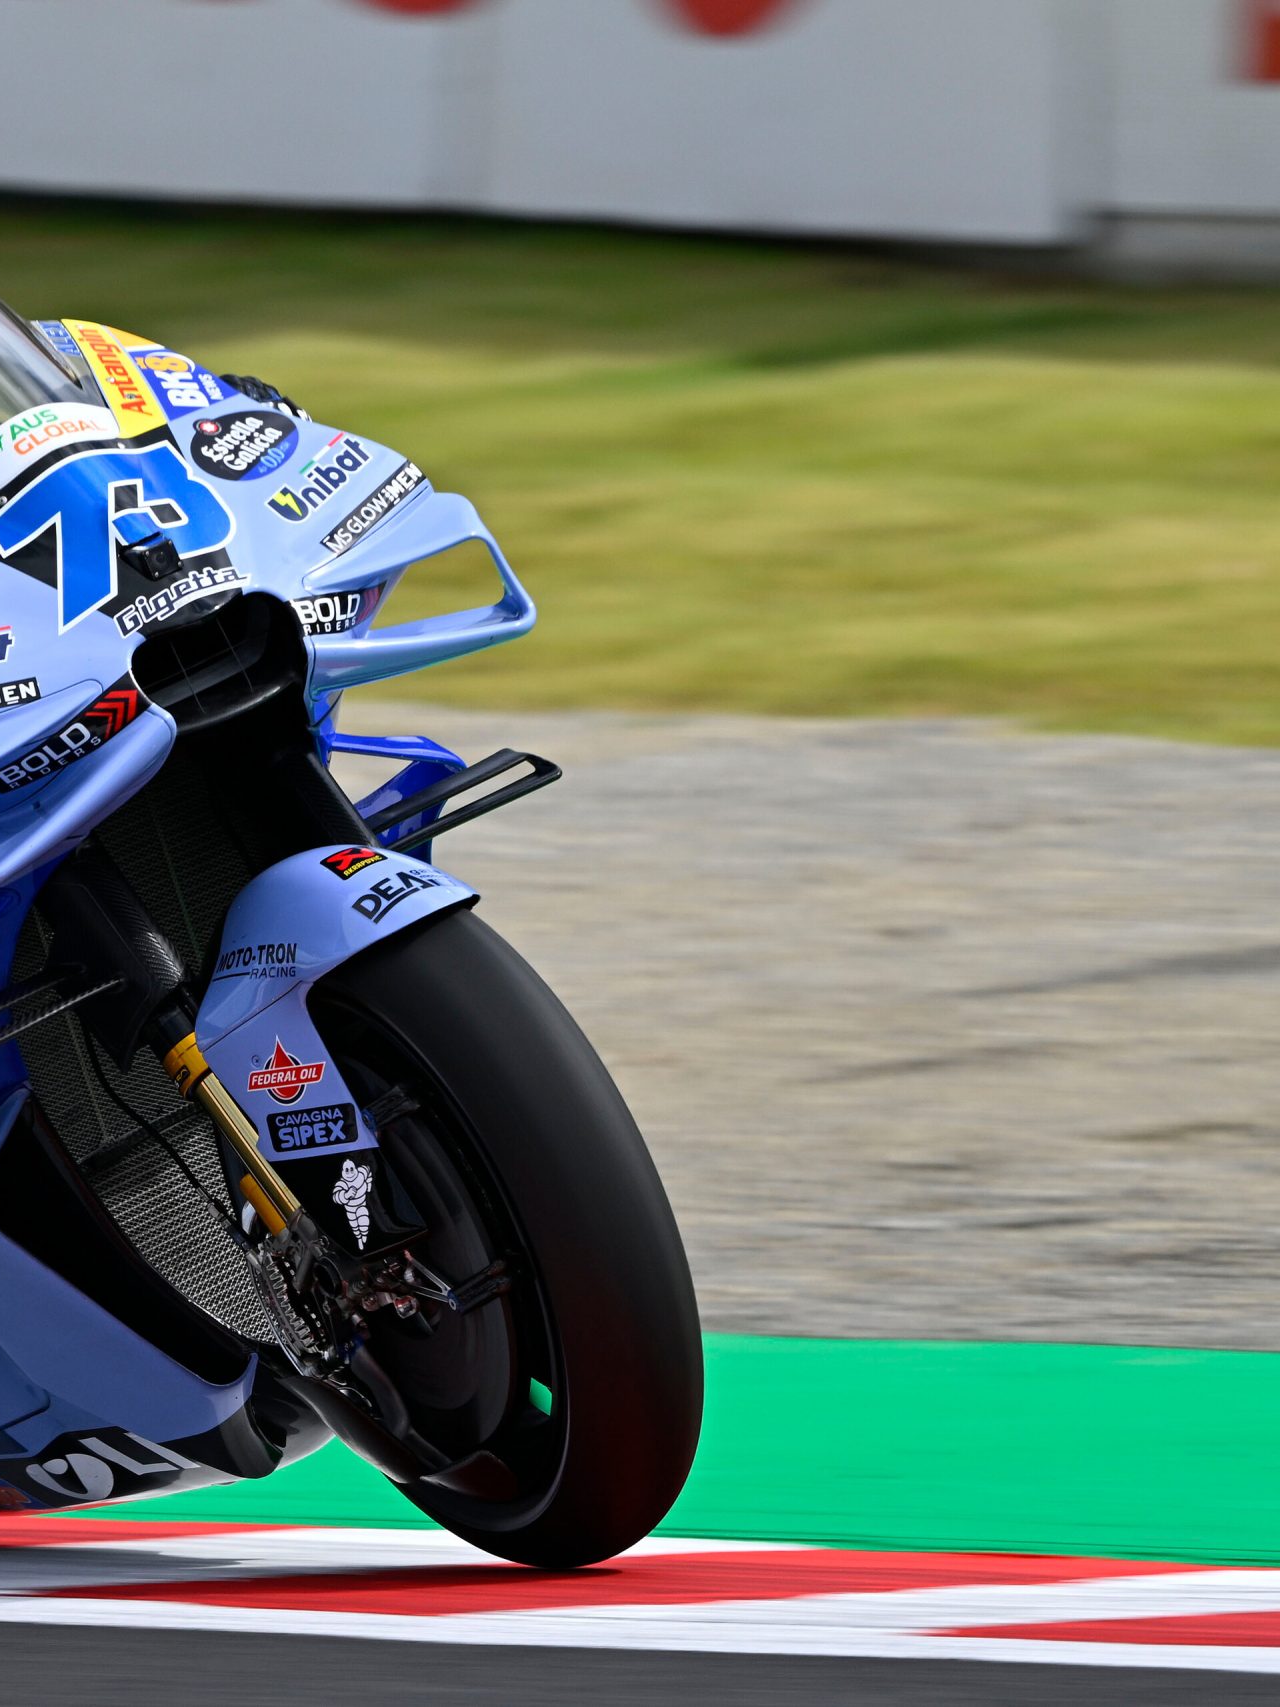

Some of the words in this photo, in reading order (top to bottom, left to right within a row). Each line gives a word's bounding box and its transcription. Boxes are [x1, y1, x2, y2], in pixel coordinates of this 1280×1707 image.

[79, 326, 153, 417] Antangin
[144, 353, 210, 408] BK8
[10, 409, 59, 441] AUS
[13, 418, 109, 456] GLOBAL
[201, 416, 264, 462] Estrella
[222, 427, 283, 471] Galicia
[267, 437, 370, 522] Unibat
[323, 527, 352, 556] MS
[348, 494, 389, 534] GLOW
[114, 566, 251, 638] Gigetta
[294, 593, 361, 627] BOLD
[303, 617, 357, 636] RIDERS
[9, 736, 102, 791] RIDERS
[216, 943, 298, 974] MOTO-TRON
[249, 966, 297, 980] RACING
[251, 1070, 298, 1087] FEDERAL
[299, 1068, 319, 1081] OIL
[275, 1107, 344, 1127] CAVAGNA
[278, 1119, 347, 1149] SIPEX
